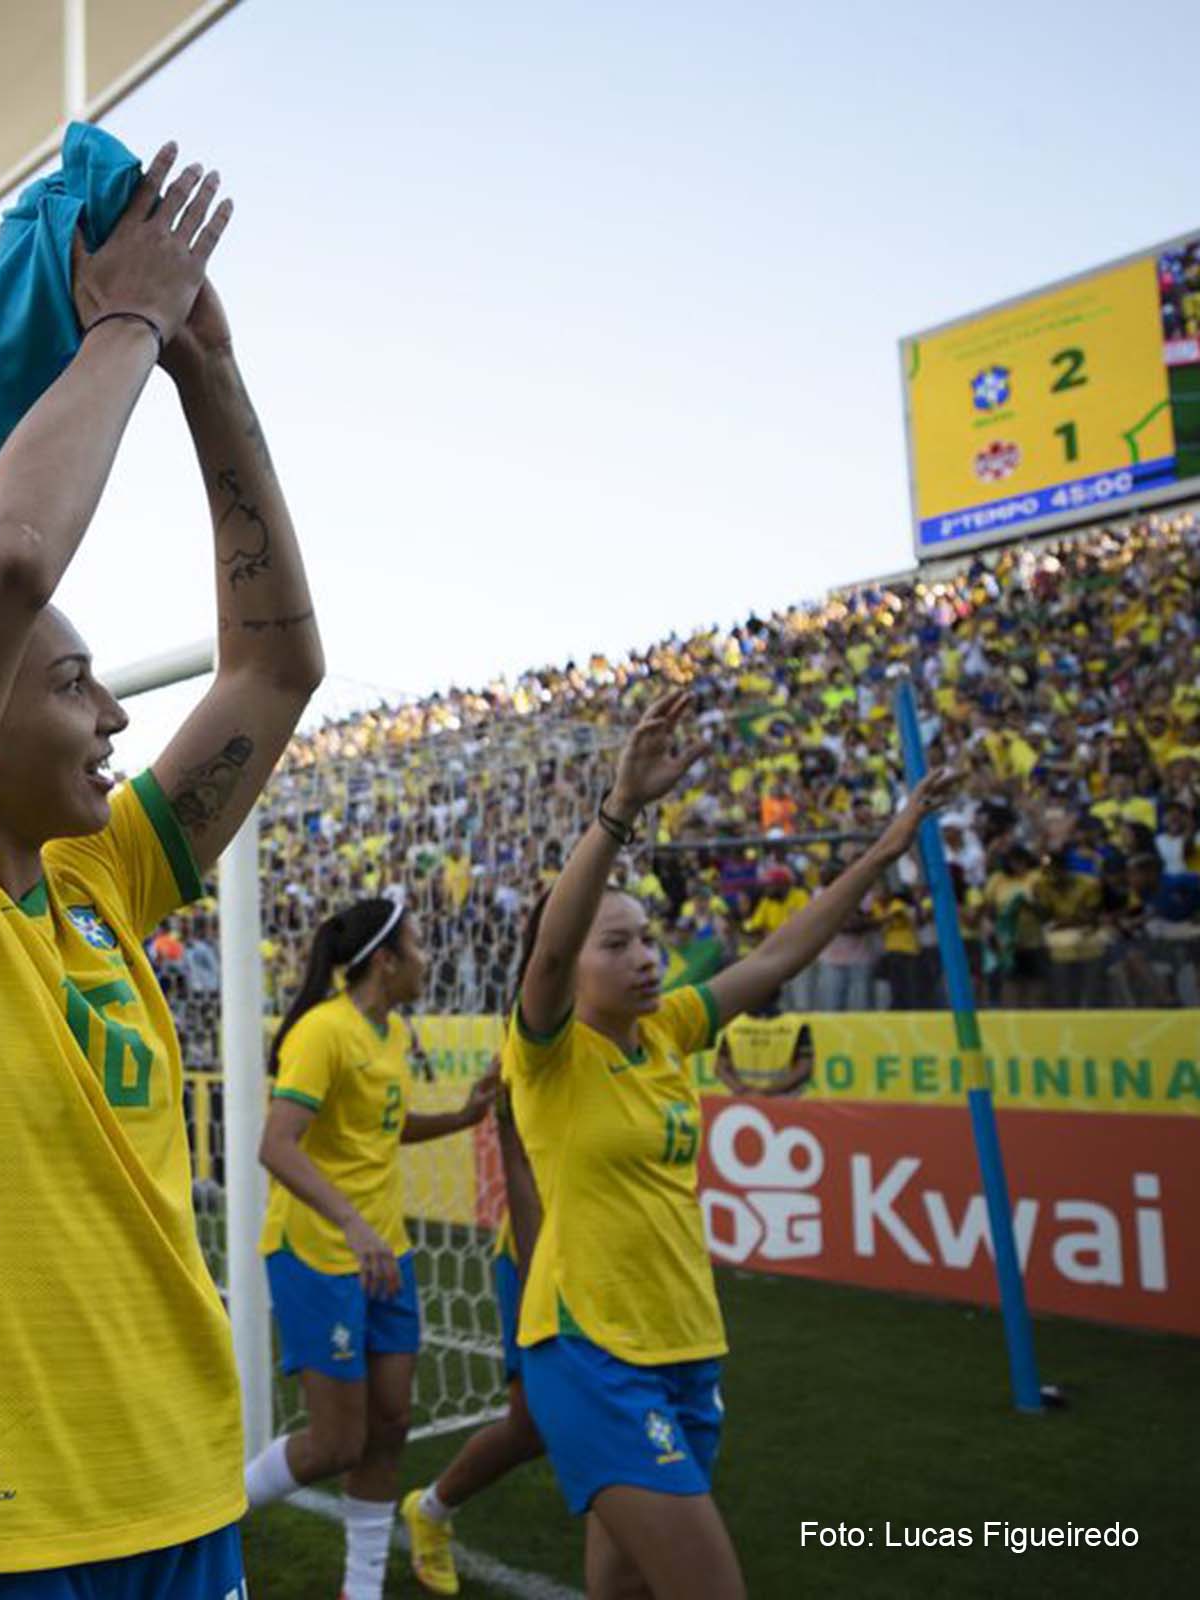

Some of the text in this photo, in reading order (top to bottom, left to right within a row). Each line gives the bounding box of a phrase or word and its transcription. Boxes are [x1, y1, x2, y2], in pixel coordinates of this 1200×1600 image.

[1050, 347, 1089, 393] 2
[1054, 421, 1079, 462] 1
[381, 1084, 401, 1132] 2
[662, 1101, 698, 1166] 15
[850, 1153, 1168, 1292] Kwai
